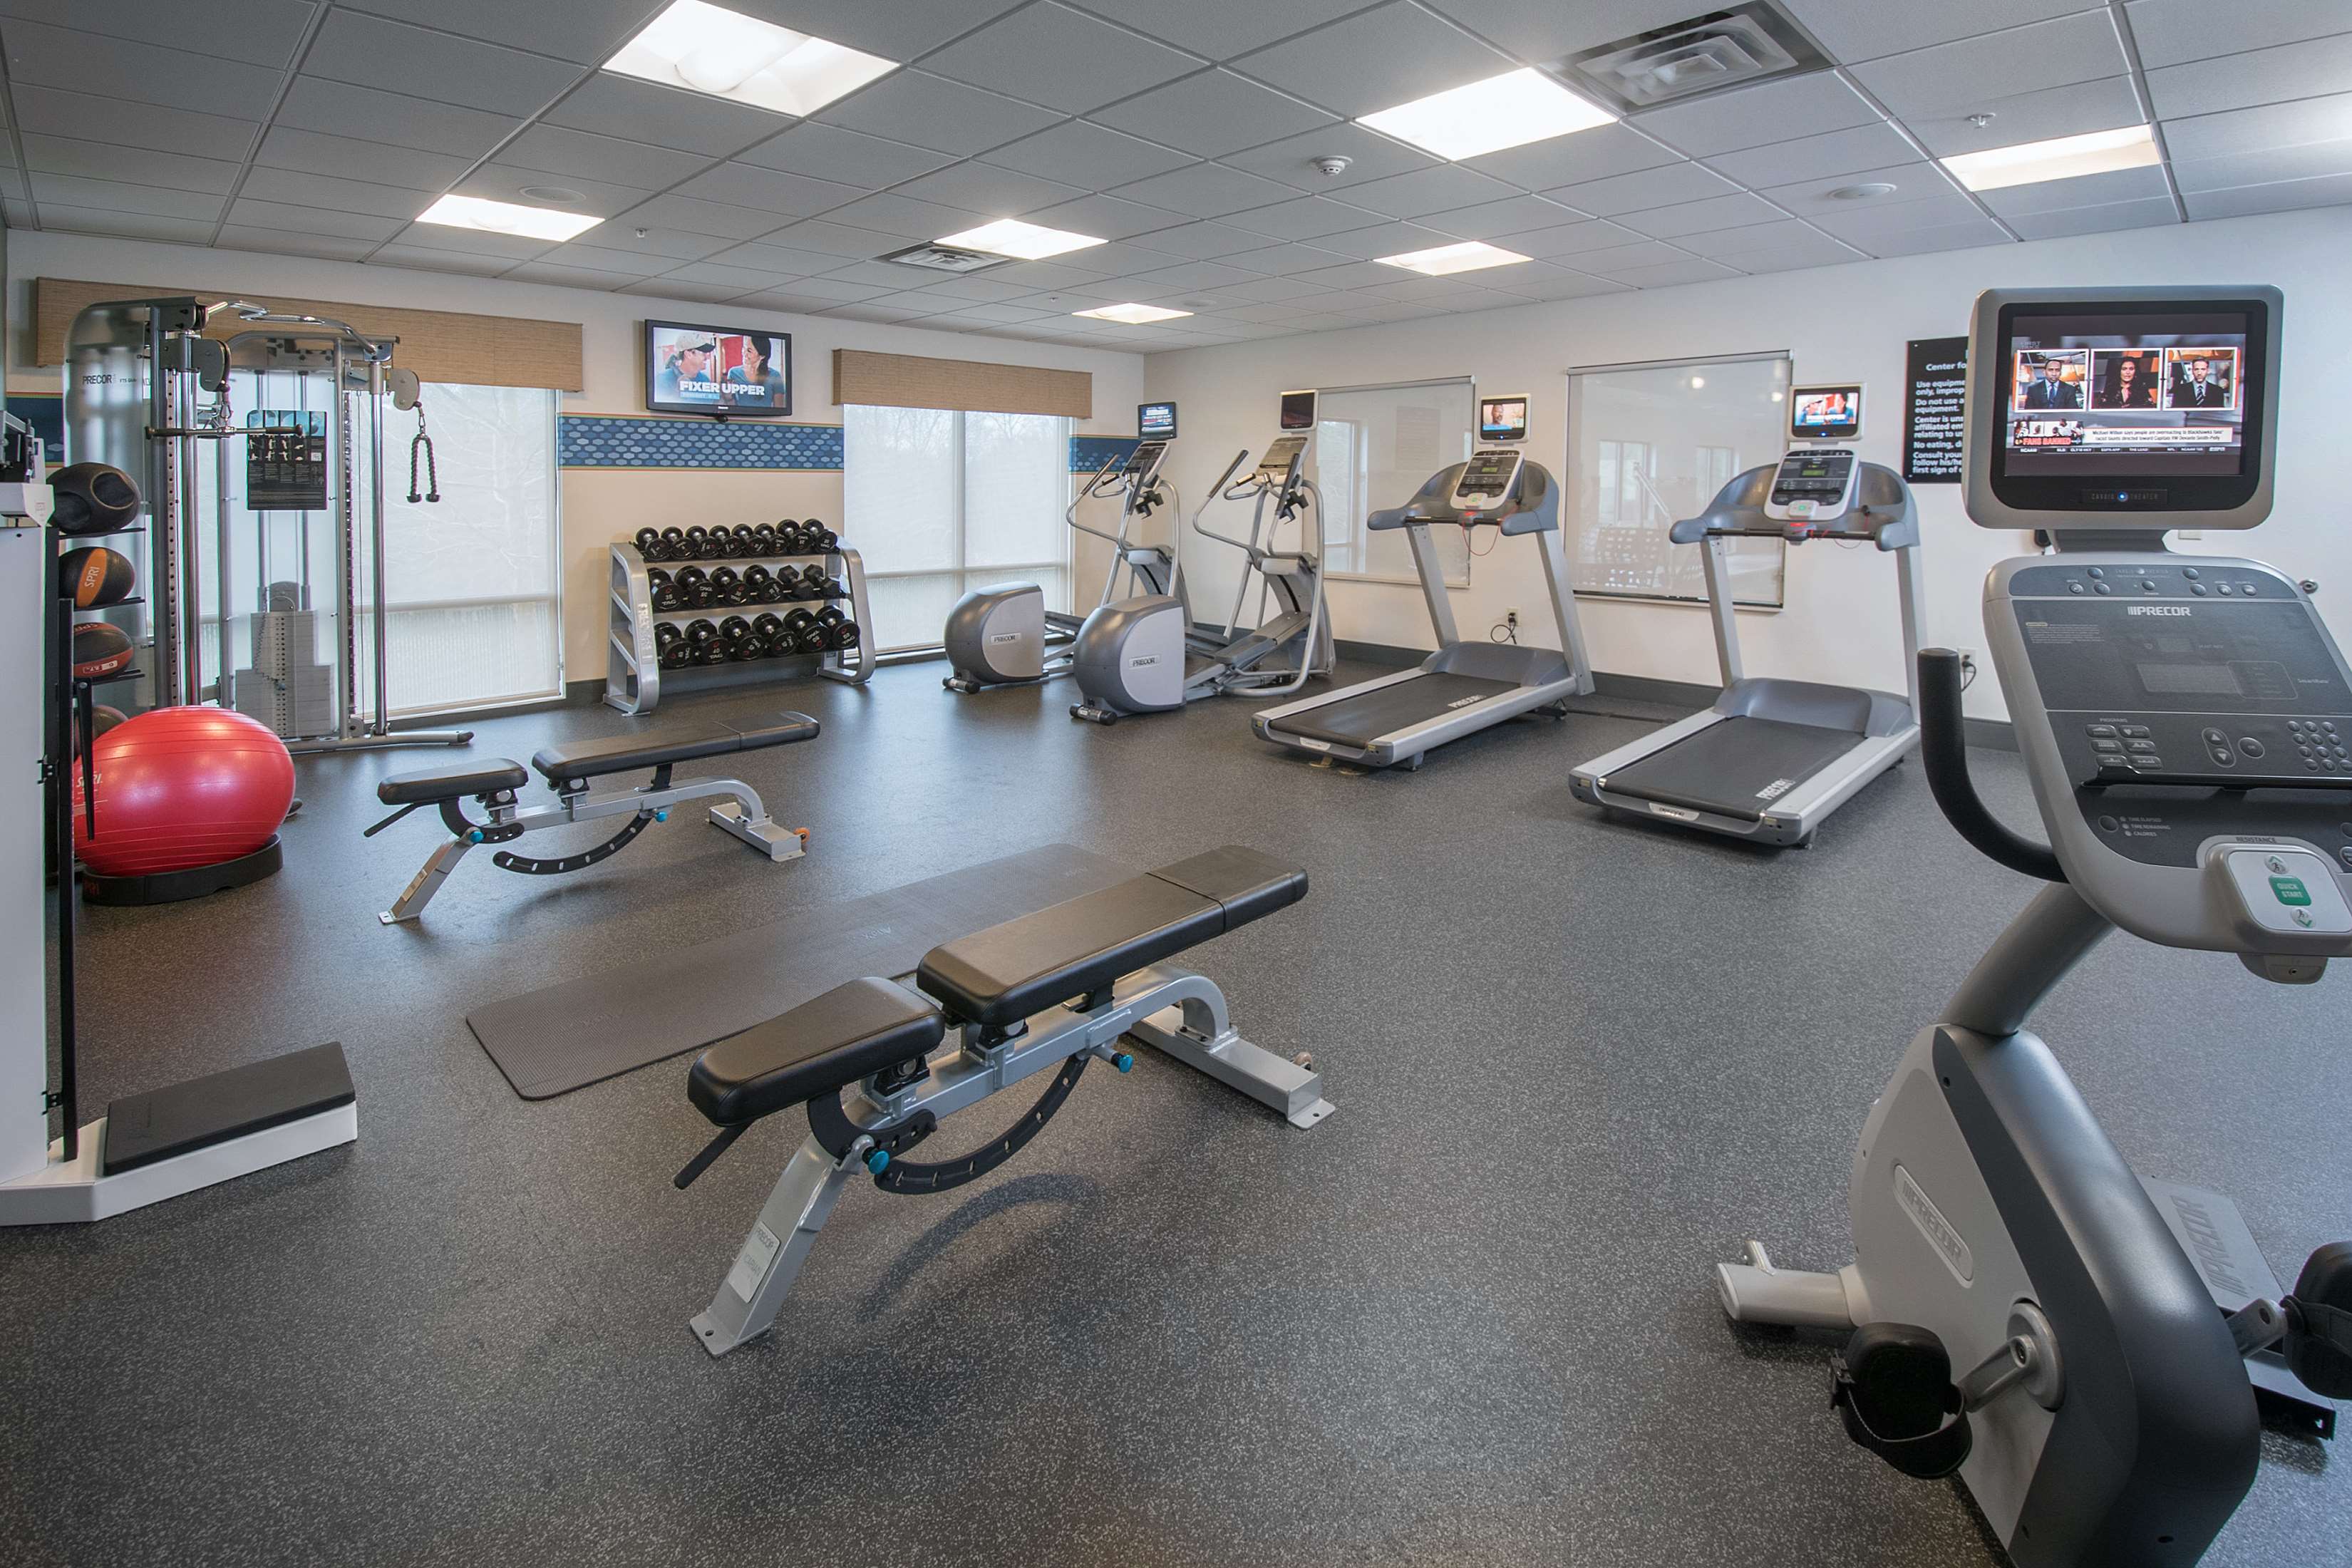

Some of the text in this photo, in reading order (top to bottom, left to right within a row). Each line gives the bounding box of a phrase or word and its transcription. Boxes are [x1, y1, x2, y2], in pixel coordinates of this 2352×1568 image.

[1926, 363, 1955, 371] Center
[83, 374, 112, 384] PRECOR
[679, 381, 765, 396] FIXER UPPER
[1914, 406, 1959, 414] equipment.
[1914, 430, 1944, 439] relating
[1927, 440, 1954, 449] eating,
[1930, 465, 1946, 475] sign
[84, 567, 100, 588] SPRI
[2138, 606, 2191, 616] PRECOR
[806, 630, 820, 640] TAG
[842, 635, 855, 644] TAG
[1133, 658, 1155, 667] PRECOR
[1906, 1183, 1961, 1259] PRECOR
